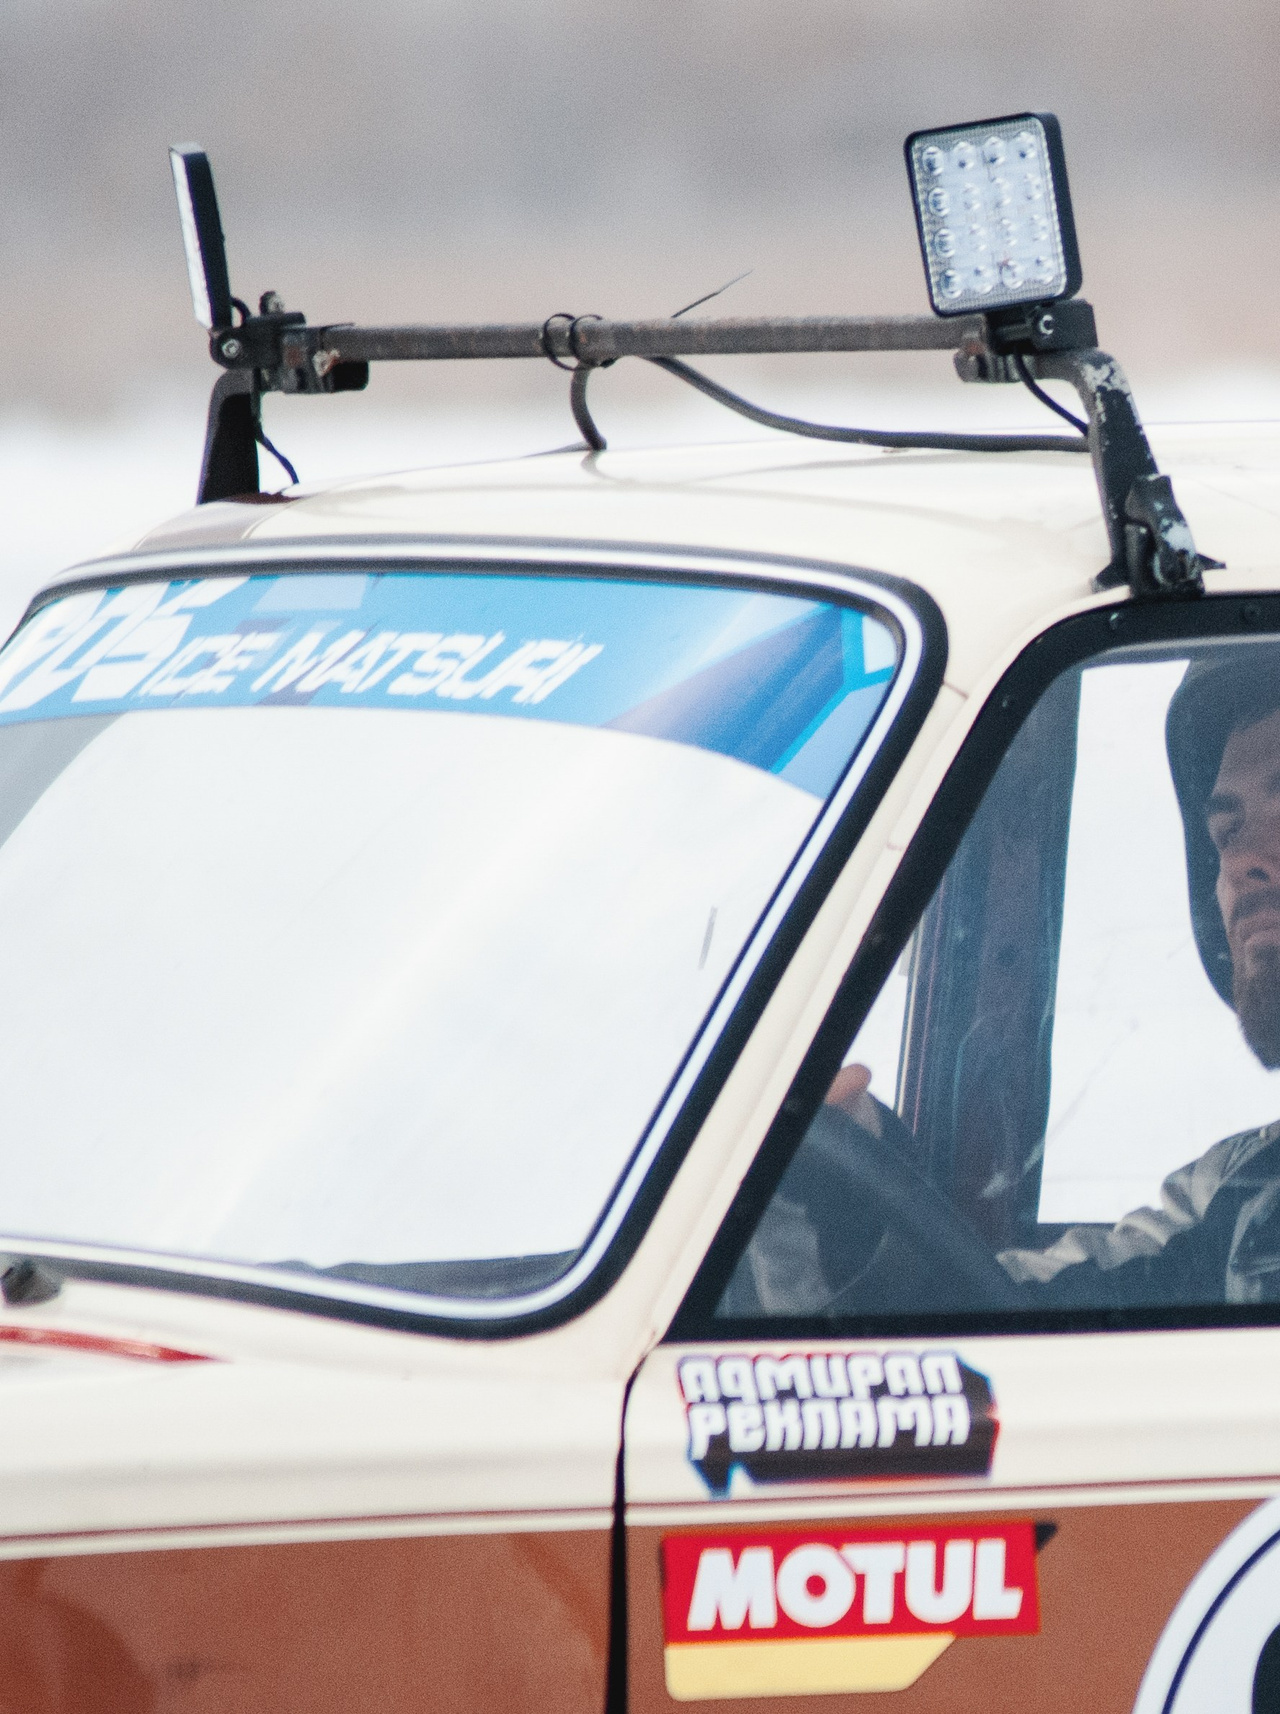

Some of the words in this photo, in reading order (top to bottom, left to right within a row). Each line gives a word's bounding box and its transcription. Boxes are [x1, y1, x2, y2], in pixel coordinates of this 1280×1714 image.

[136, 632, 284, 697] ICE
[250, 629, 605, 705] MATSURI
[687, 1538, 1024, 1632] MOTUL
